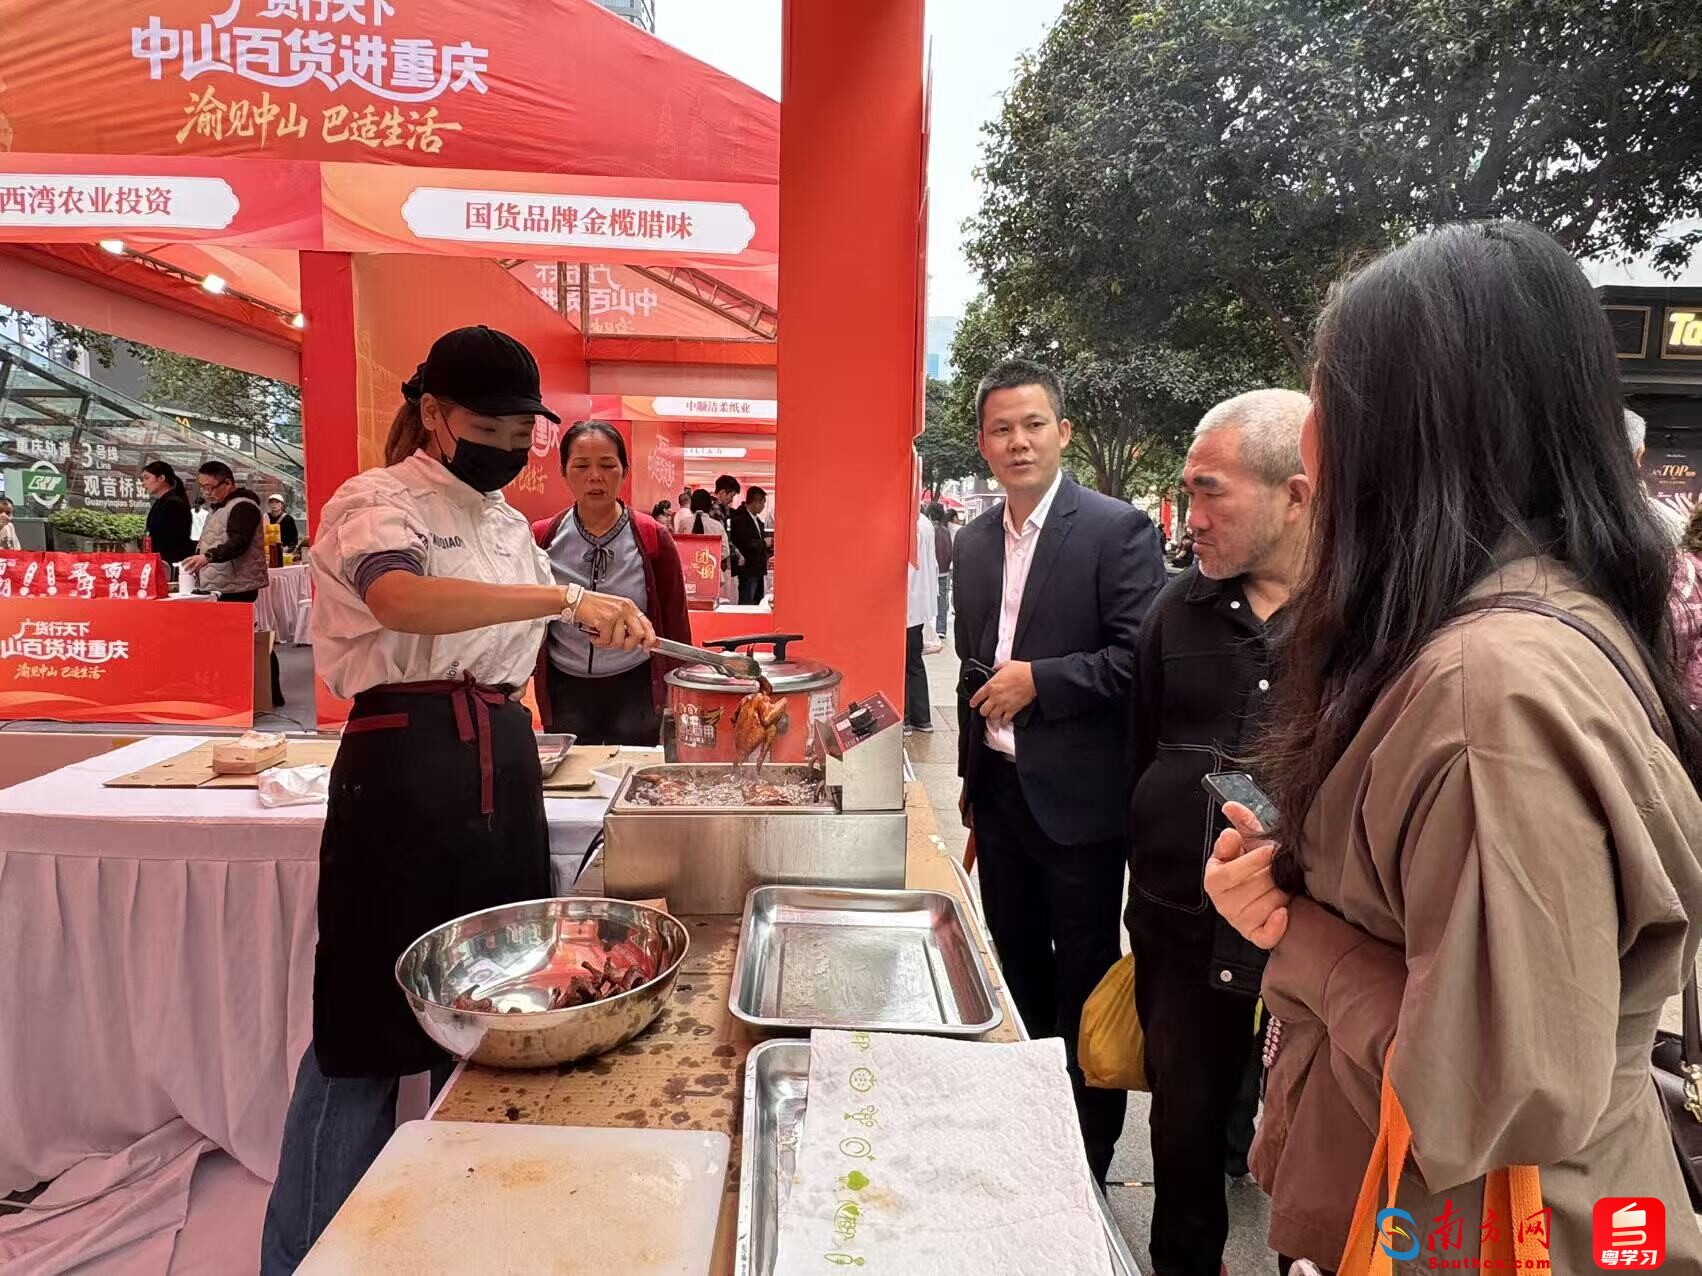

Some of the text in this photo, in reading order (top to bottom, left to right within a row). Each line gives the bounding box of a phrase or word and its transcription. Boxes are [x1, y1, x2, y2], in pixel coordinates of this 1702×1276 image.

[132, 16, 489, 103] 中山百货进重庆
[176, 85, 463, 154] 渝见中山 巴适生活
[0, 184, 173, 216] 西湾农业投资
[465, 201, 693, 240] 国货品牌金榄腊味
[686, 400, 751, 414] 中顺洁柔纸业
[16, 437, 71, 462] 重庆轨道
[81, 442, 119, 468] 3 号线
[12, 618, 91, 640] 广货行天下
[0, 637, 129, 664] 山百货进重庆
